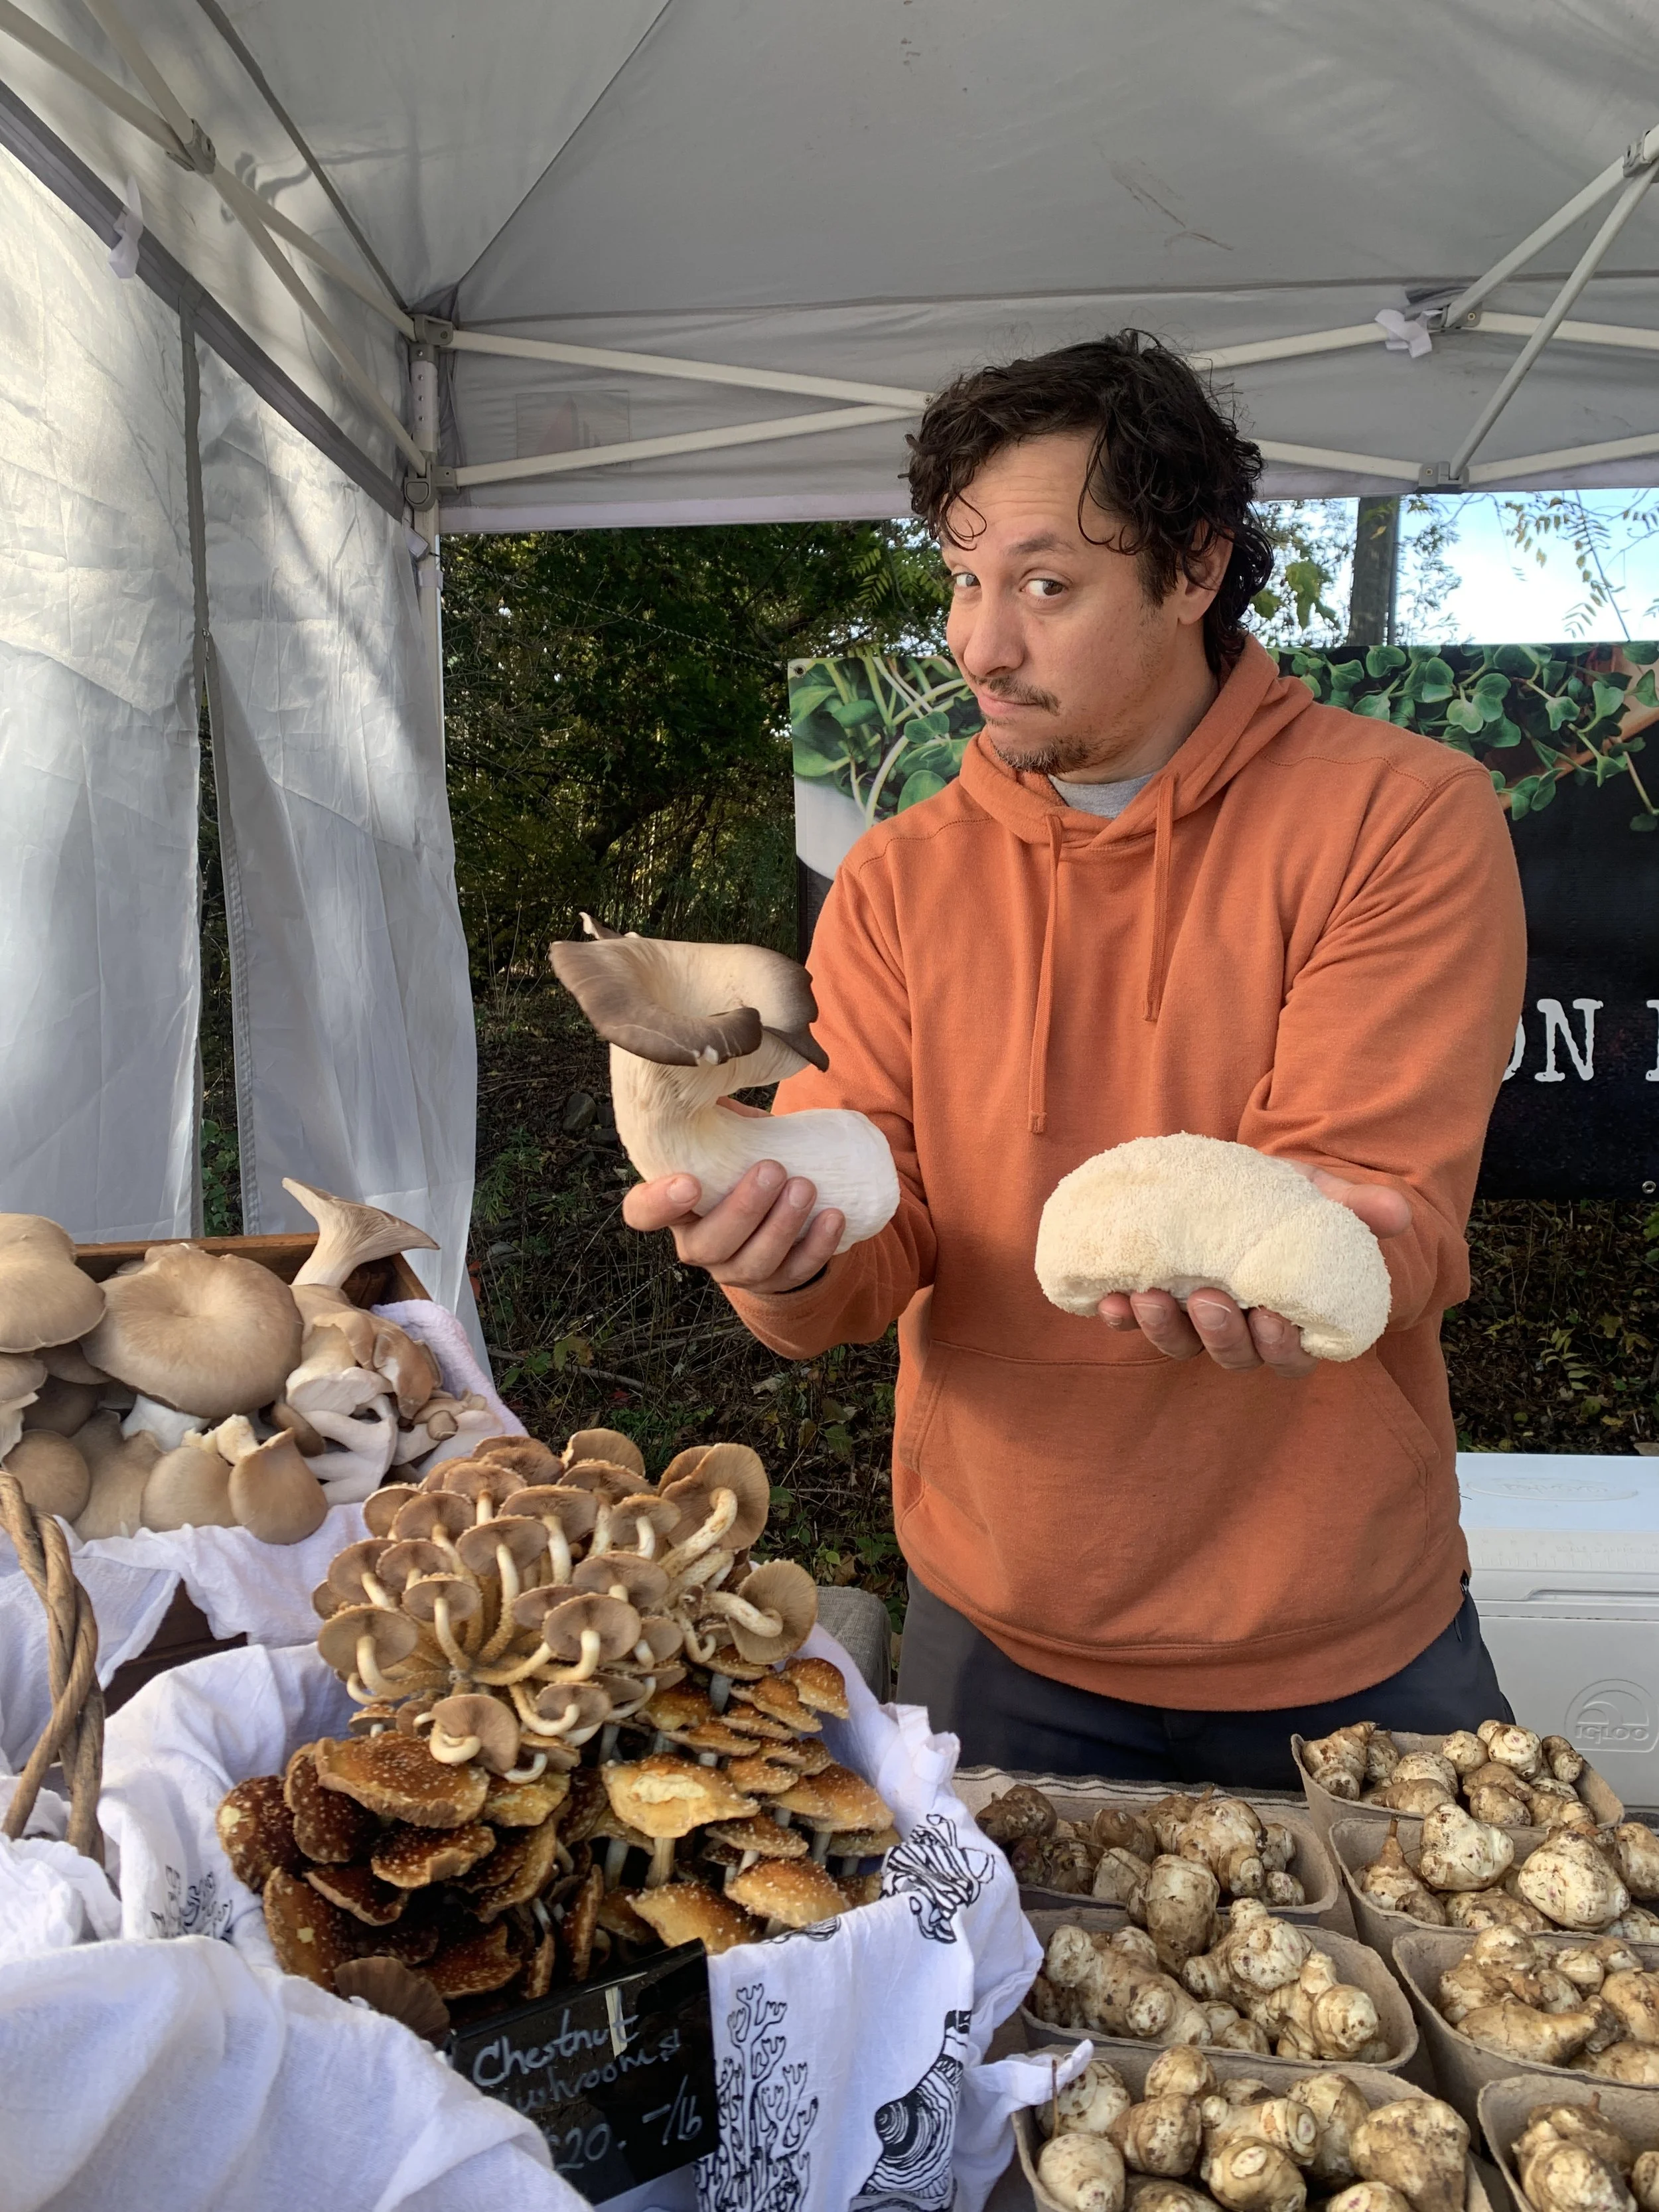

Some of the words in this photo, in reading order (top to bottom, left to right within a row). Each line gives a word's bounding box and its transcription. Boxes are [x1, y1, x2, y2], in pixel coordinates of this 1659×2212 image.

[1575, 1726, 1649, 1744] IGLOO
[472, 1986, 640, 2087] Chestnut
[502, 2028, 682, 2115] ushrooms
